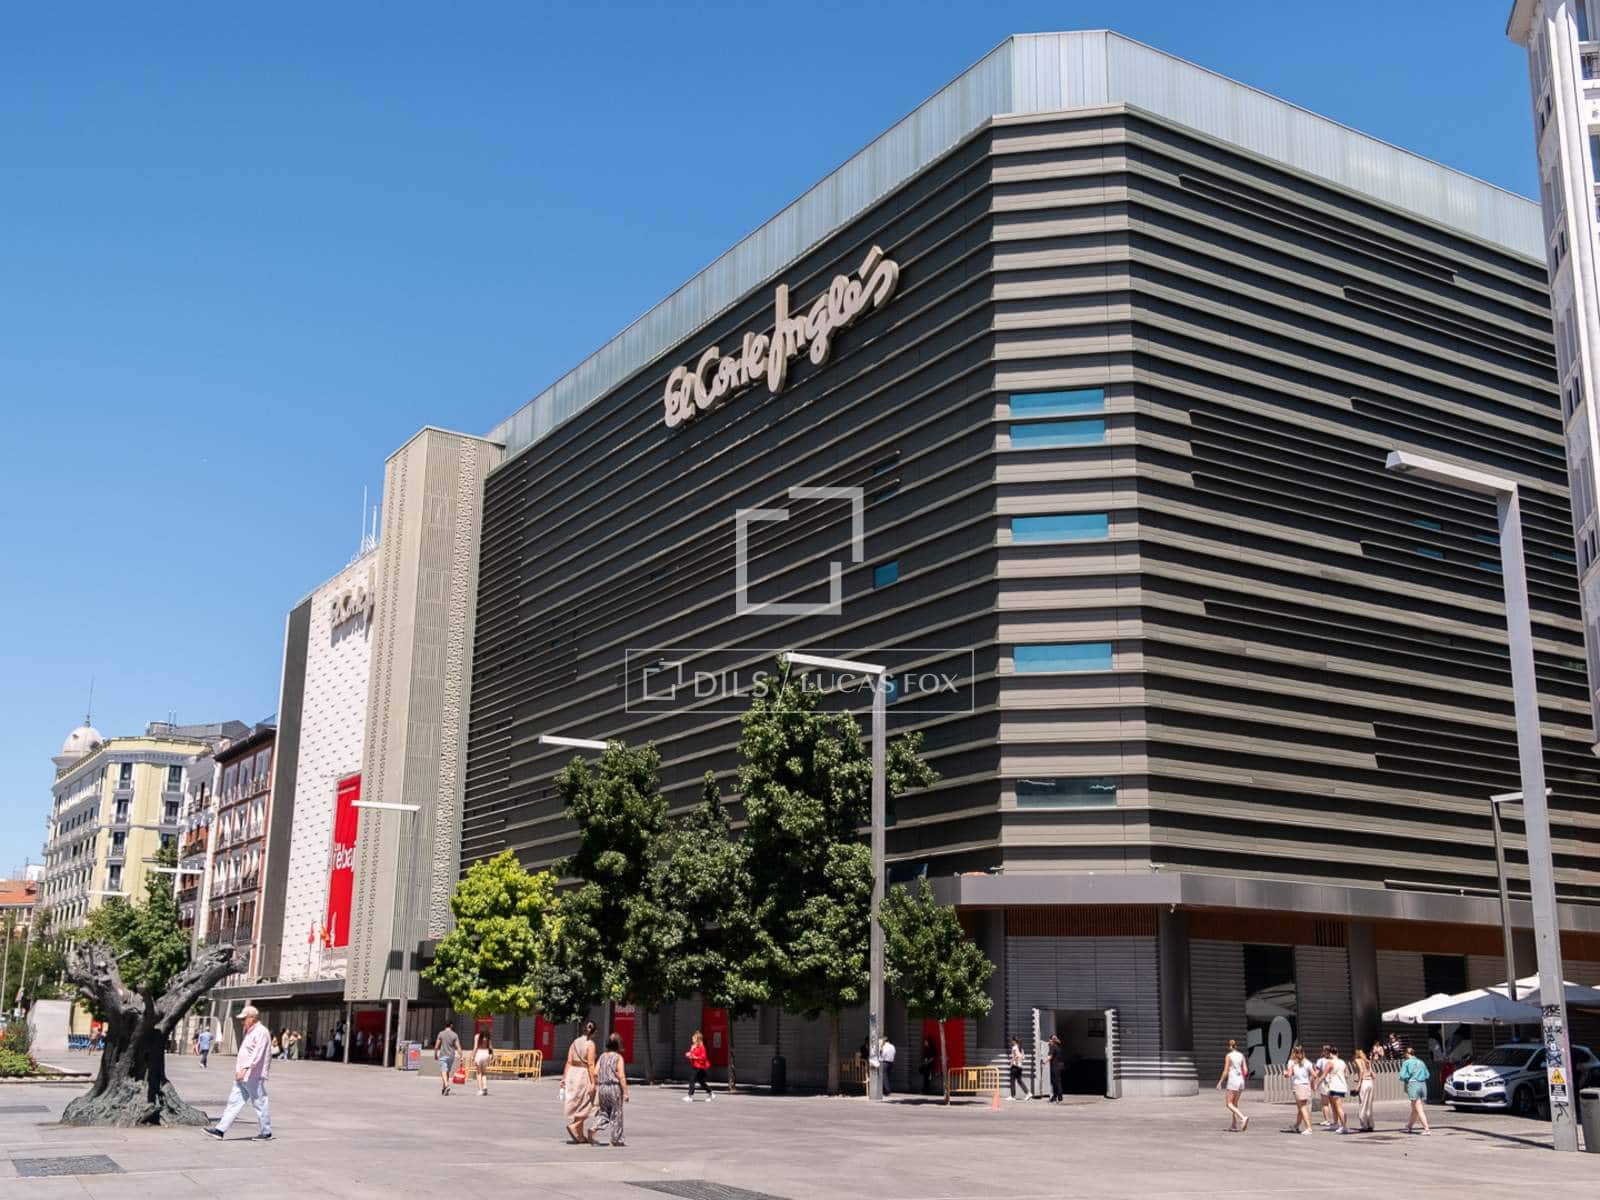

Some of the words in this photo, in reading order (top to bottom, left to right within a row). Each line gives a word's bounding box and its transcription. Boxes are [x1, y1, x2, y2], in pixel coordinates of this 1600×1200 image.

[664, 365, 696, 429] El
[695, 331, 770, 411] Corte
[767, 244, 900, 394] Inglés
